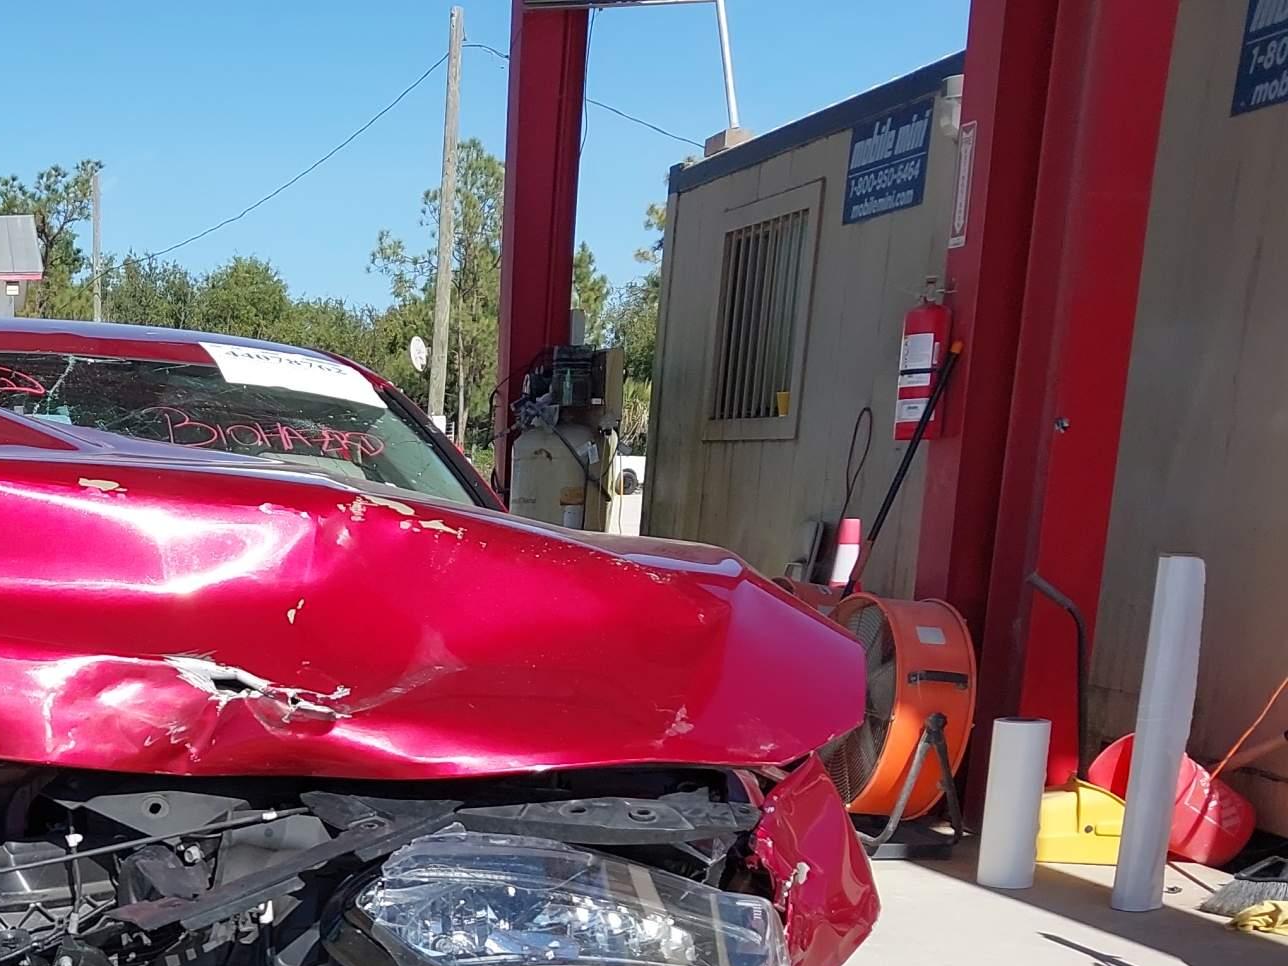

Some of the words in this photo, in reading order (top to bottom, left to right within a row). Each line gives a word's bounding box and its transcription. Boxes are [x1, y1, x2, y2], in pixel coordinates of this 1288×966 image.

[850, 117, 897, 170] mobile
[894, 109, 932, 155] mini
[850, 190, 914, 219] mobilemini.com
